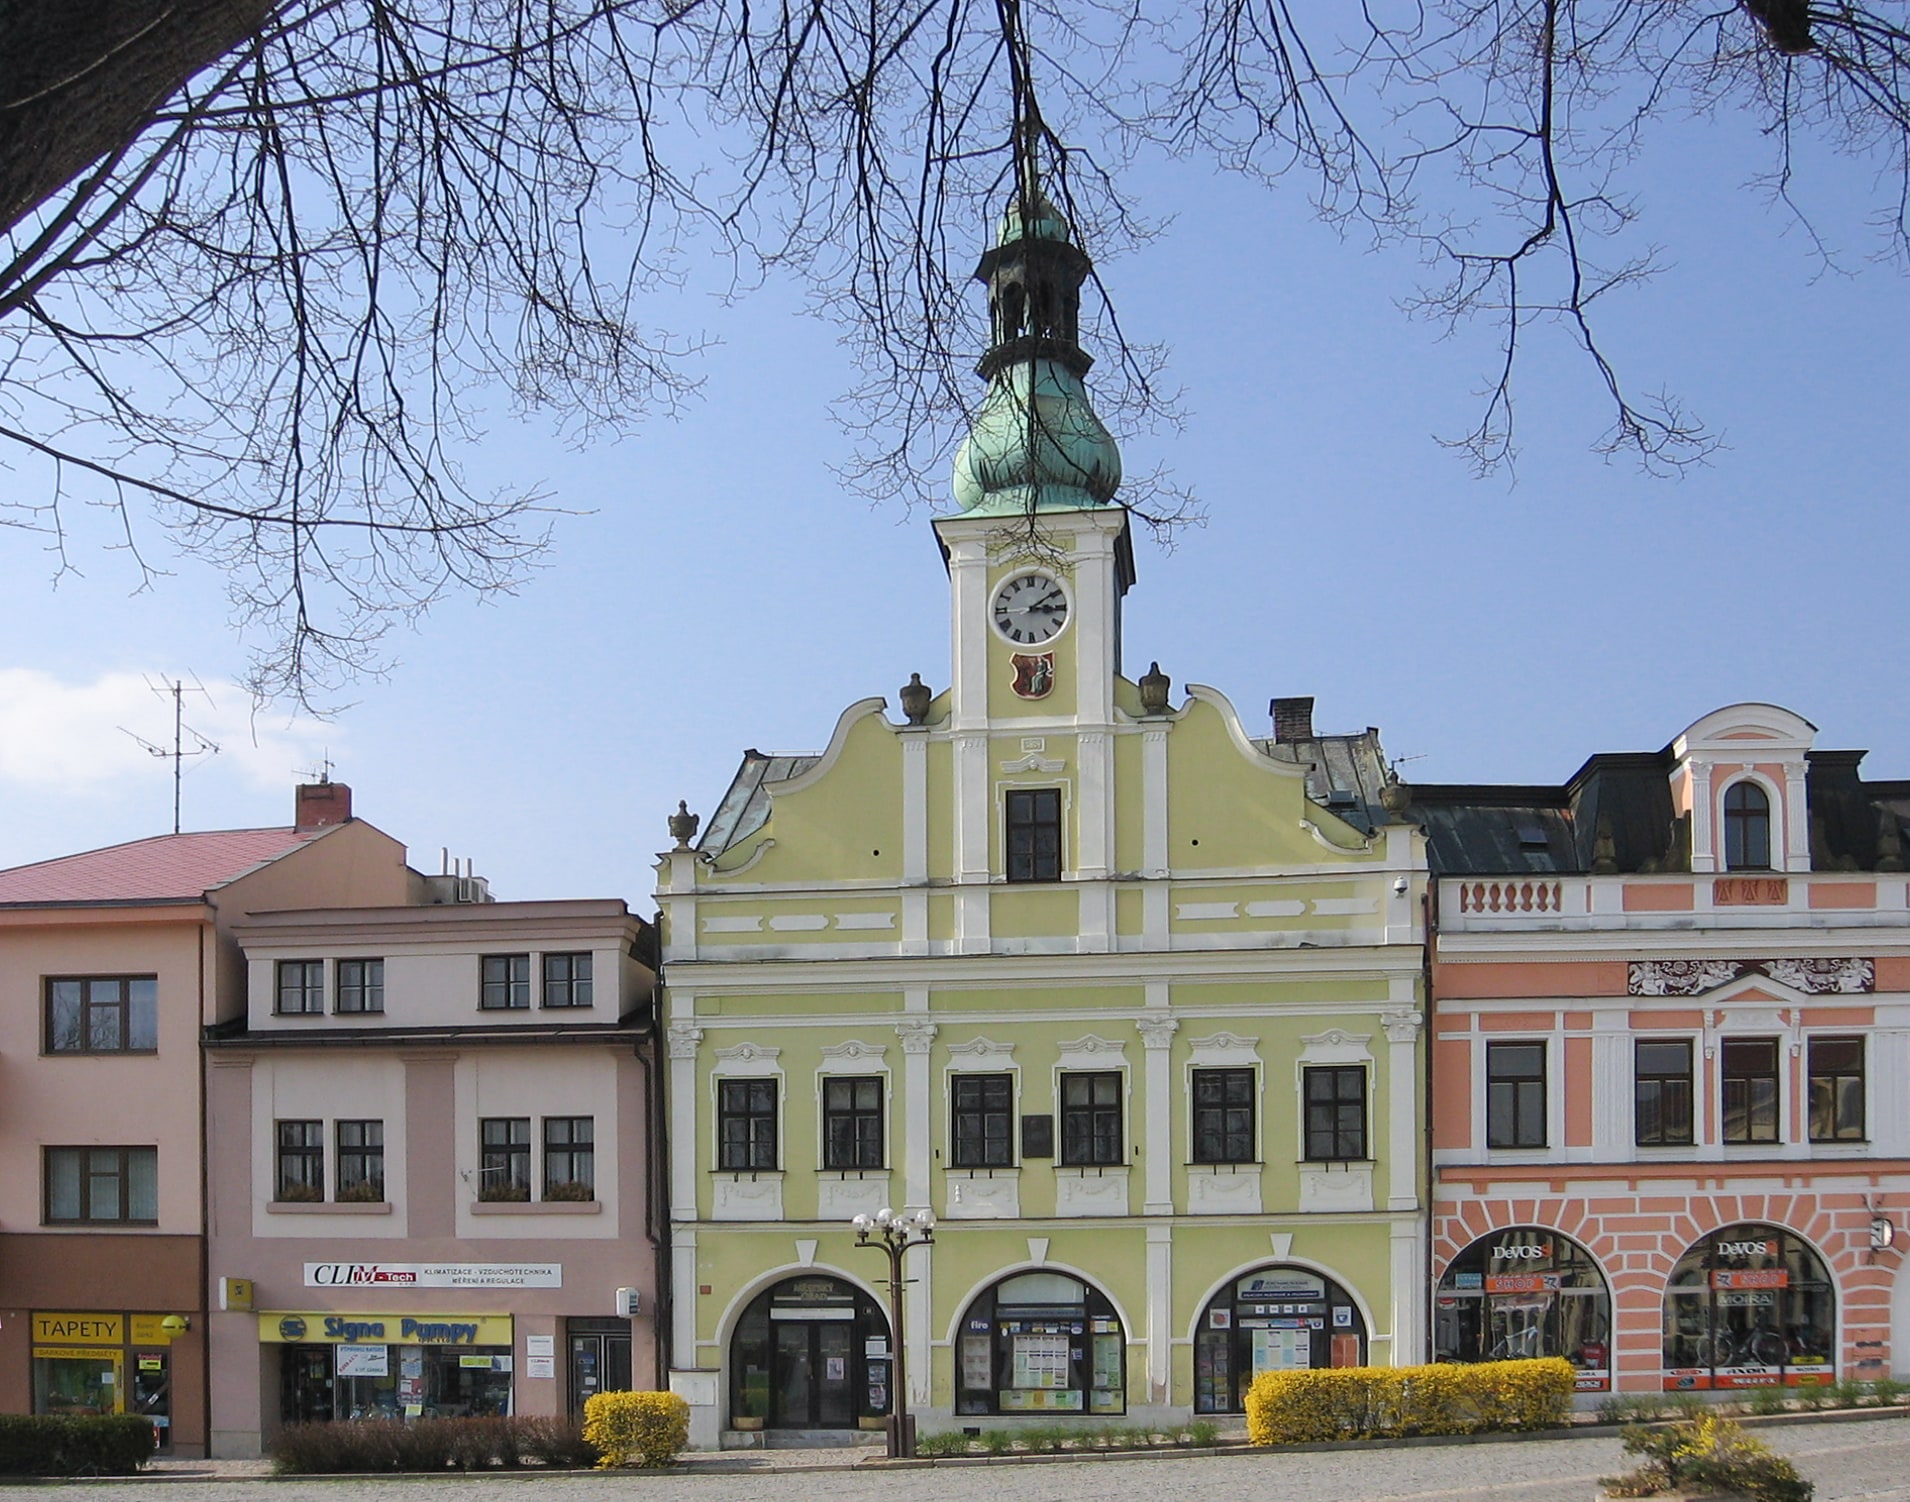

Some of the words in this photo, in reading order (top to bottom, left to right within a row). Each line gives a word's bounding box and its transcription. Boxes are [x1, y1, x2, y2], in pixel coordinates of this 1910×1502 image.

[1492, 1245, 1543, 1259] DeVOS
[1716, 1241, 1767, 1256] DeVOS
[424, 1268, 473, 1276] KLIMATIZACE
[479, 1268, 553, 1276] VZDUCHOTECHNIKA
[486, 1277, 524, 1285] REGULACE
[1496, 1278, 1536, 1289] SHOP
[1718, 1294, 1771, 1305] MOIRA
[38, 1320, 117, 1337] TAPETY
[324, 1317, 385, 1342] Signa
[401, 1318, 479, 1343] Pumpy
